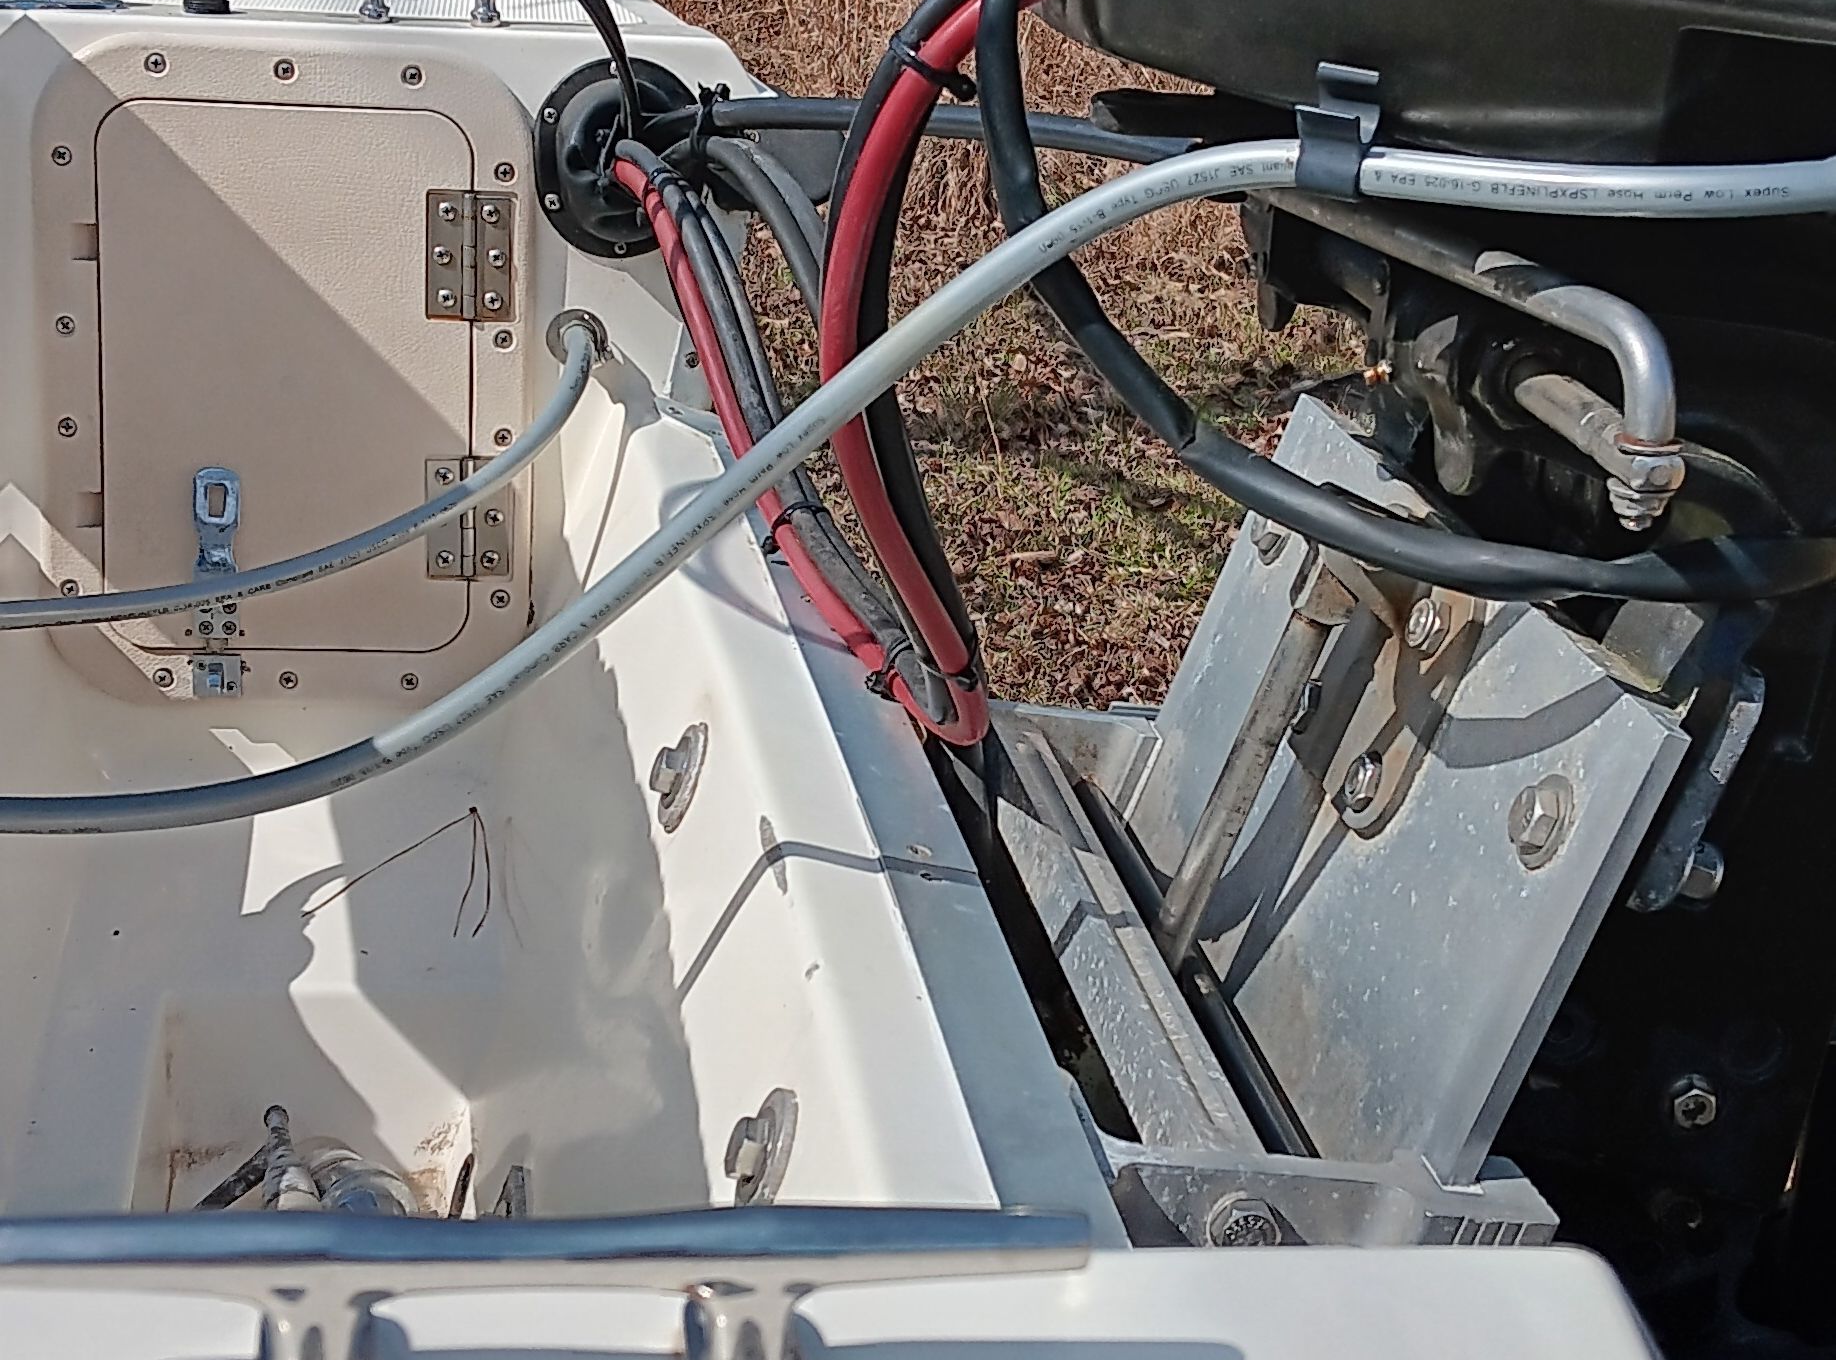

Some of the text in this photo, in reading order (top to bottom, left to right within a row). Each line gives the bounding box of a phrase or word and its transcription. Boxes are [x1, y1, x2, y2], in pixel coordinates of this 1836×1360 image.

[1229, 164, 1254, 177] SAE
[1390, 174, 1416, 186] EPA
[1607, 189, 1643, 200] Hose
[1654, 190, 1692, 202] Perm
[1704, 189, 1734, 200] Low
[247, 583, 272, 595] CARB
